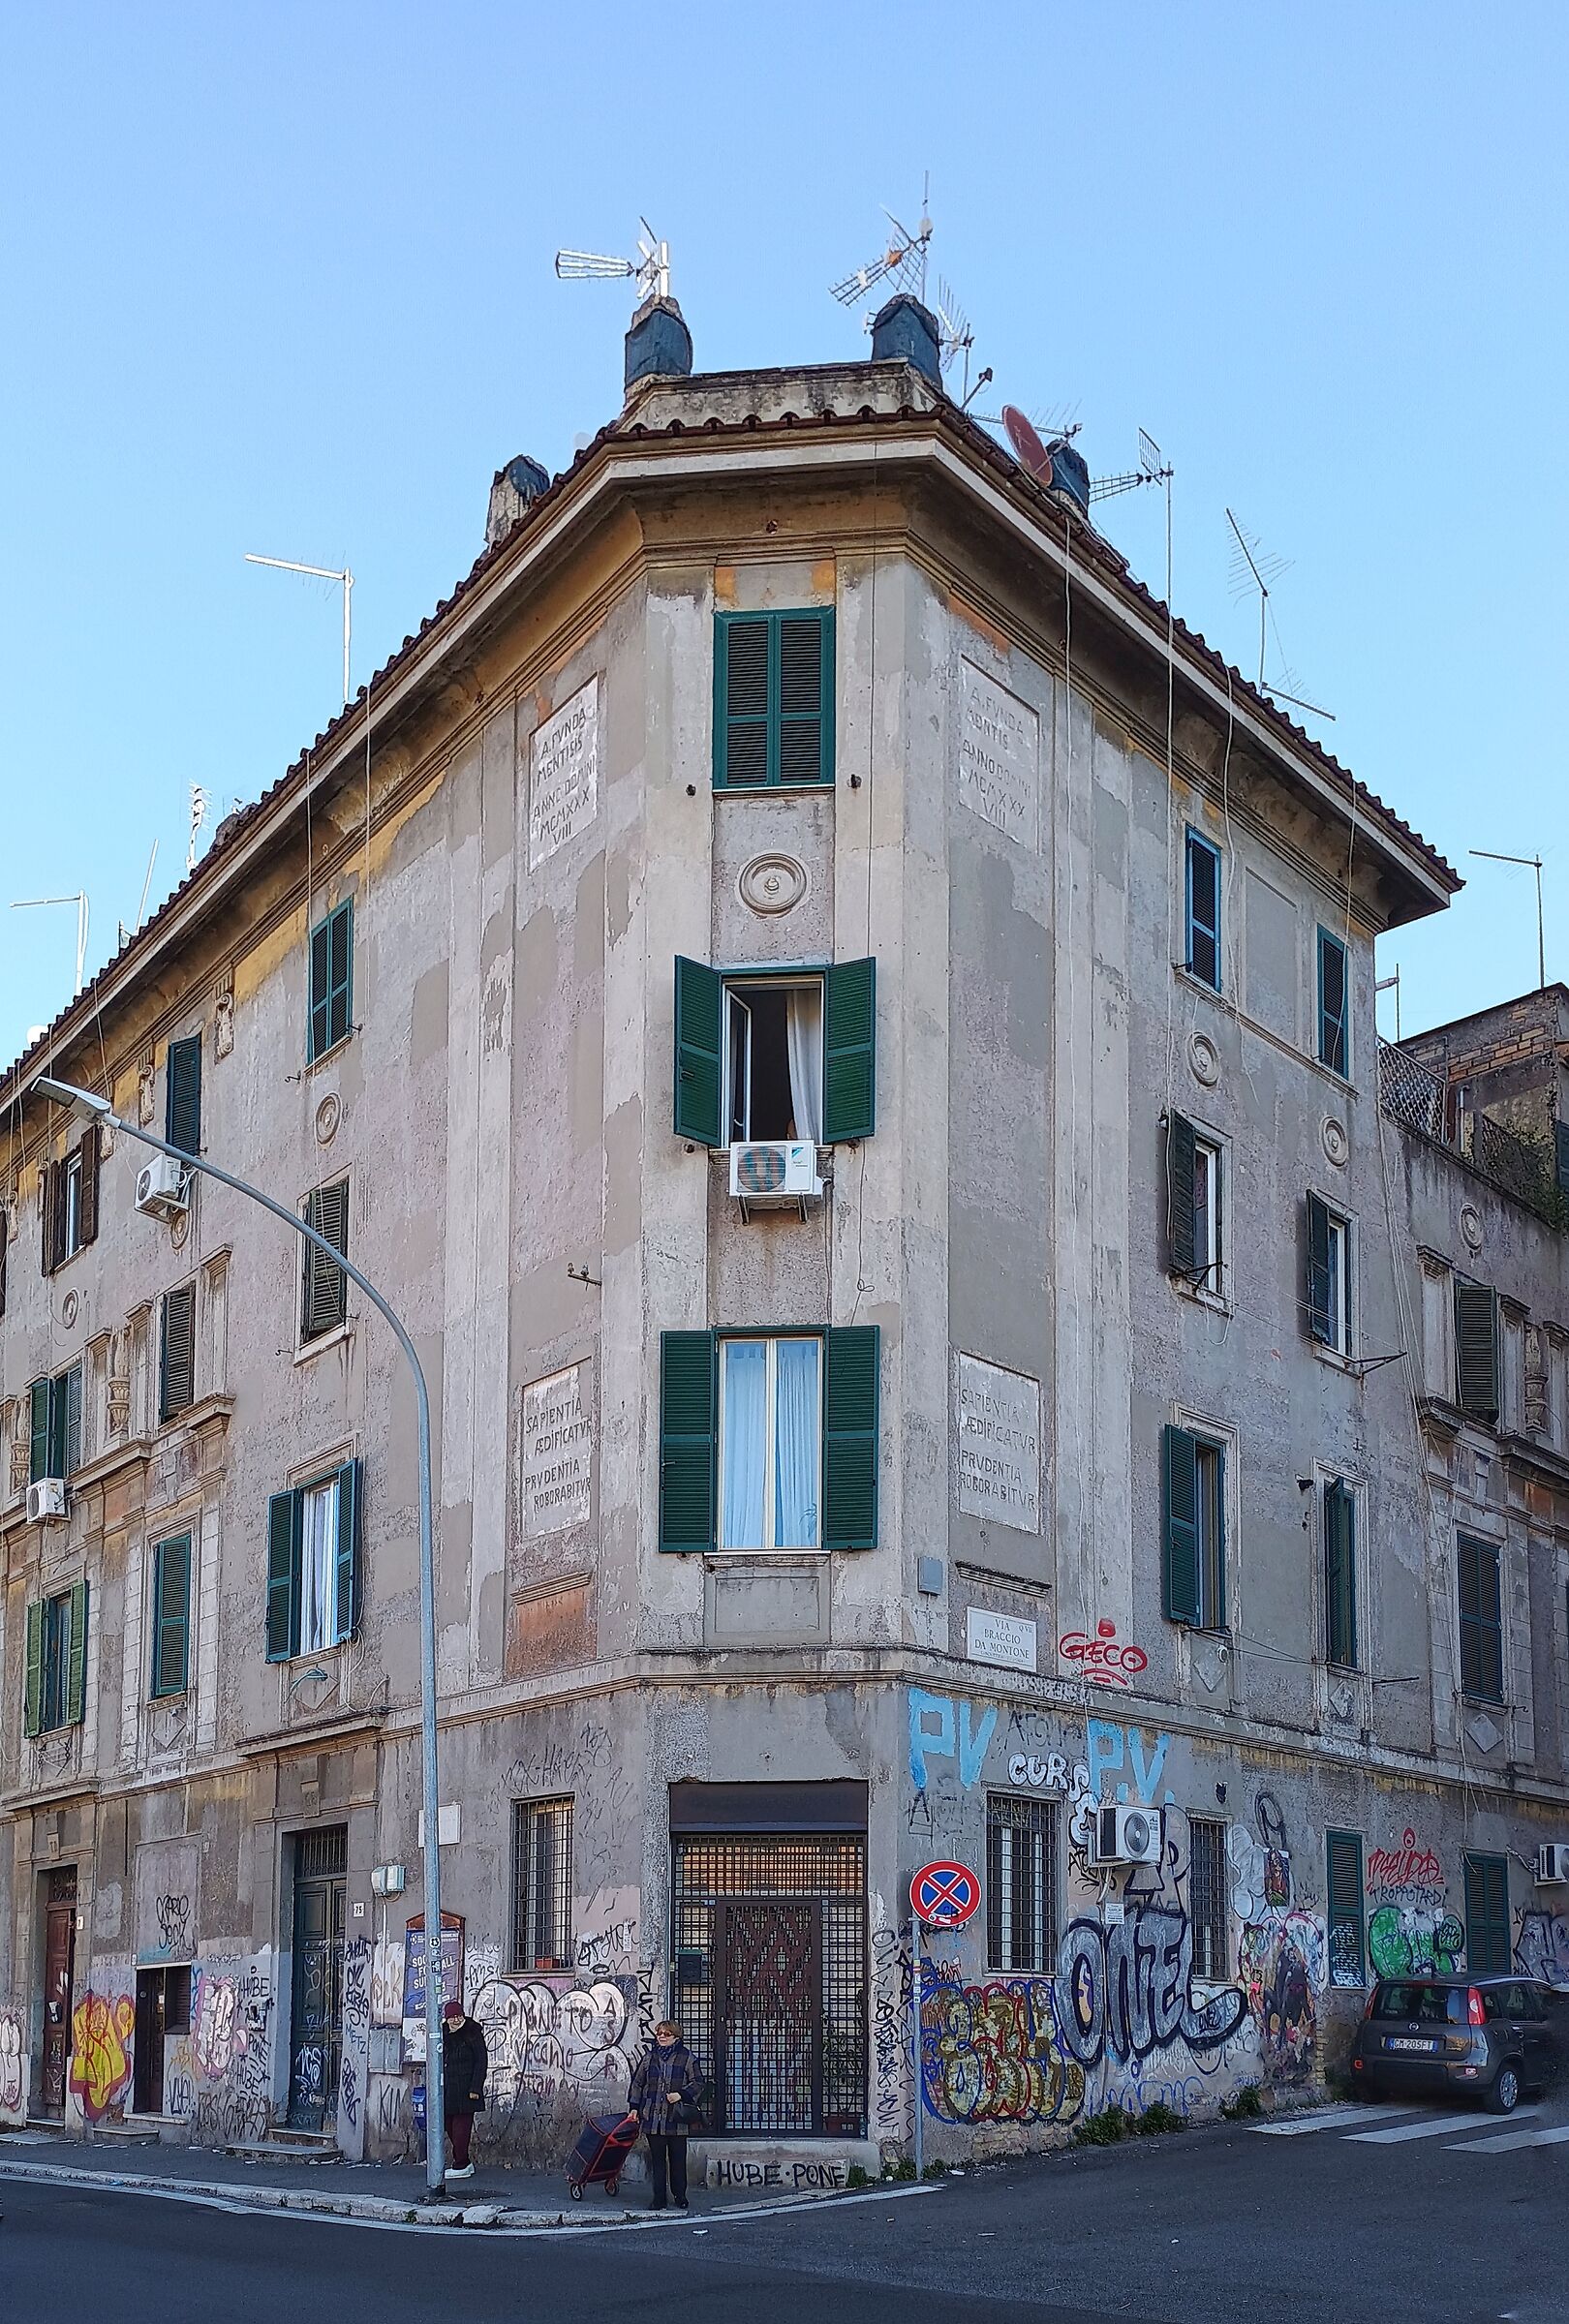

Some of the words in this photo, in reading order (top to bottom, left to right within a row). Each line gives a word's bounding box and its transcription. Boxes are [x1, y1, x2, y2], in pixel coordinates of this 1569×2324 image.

[526, 1394, 582, 1434] SAPIENTIA
[525, 1457, 580, 1493] PRVDENTIA
[962, 1450, 1022, 1484] PRVDENTIA
[984, 1628, 1021, 1645] BRACCIO
[995, 1618, 1010, 1632] VIA
[974, 1638, 986, 1650] DA
[990, 1642, 1030, 1659] MONTONE
[1059, 1632, 1148, 1673] GECO
[354, 1905, 363, 1914] 75
